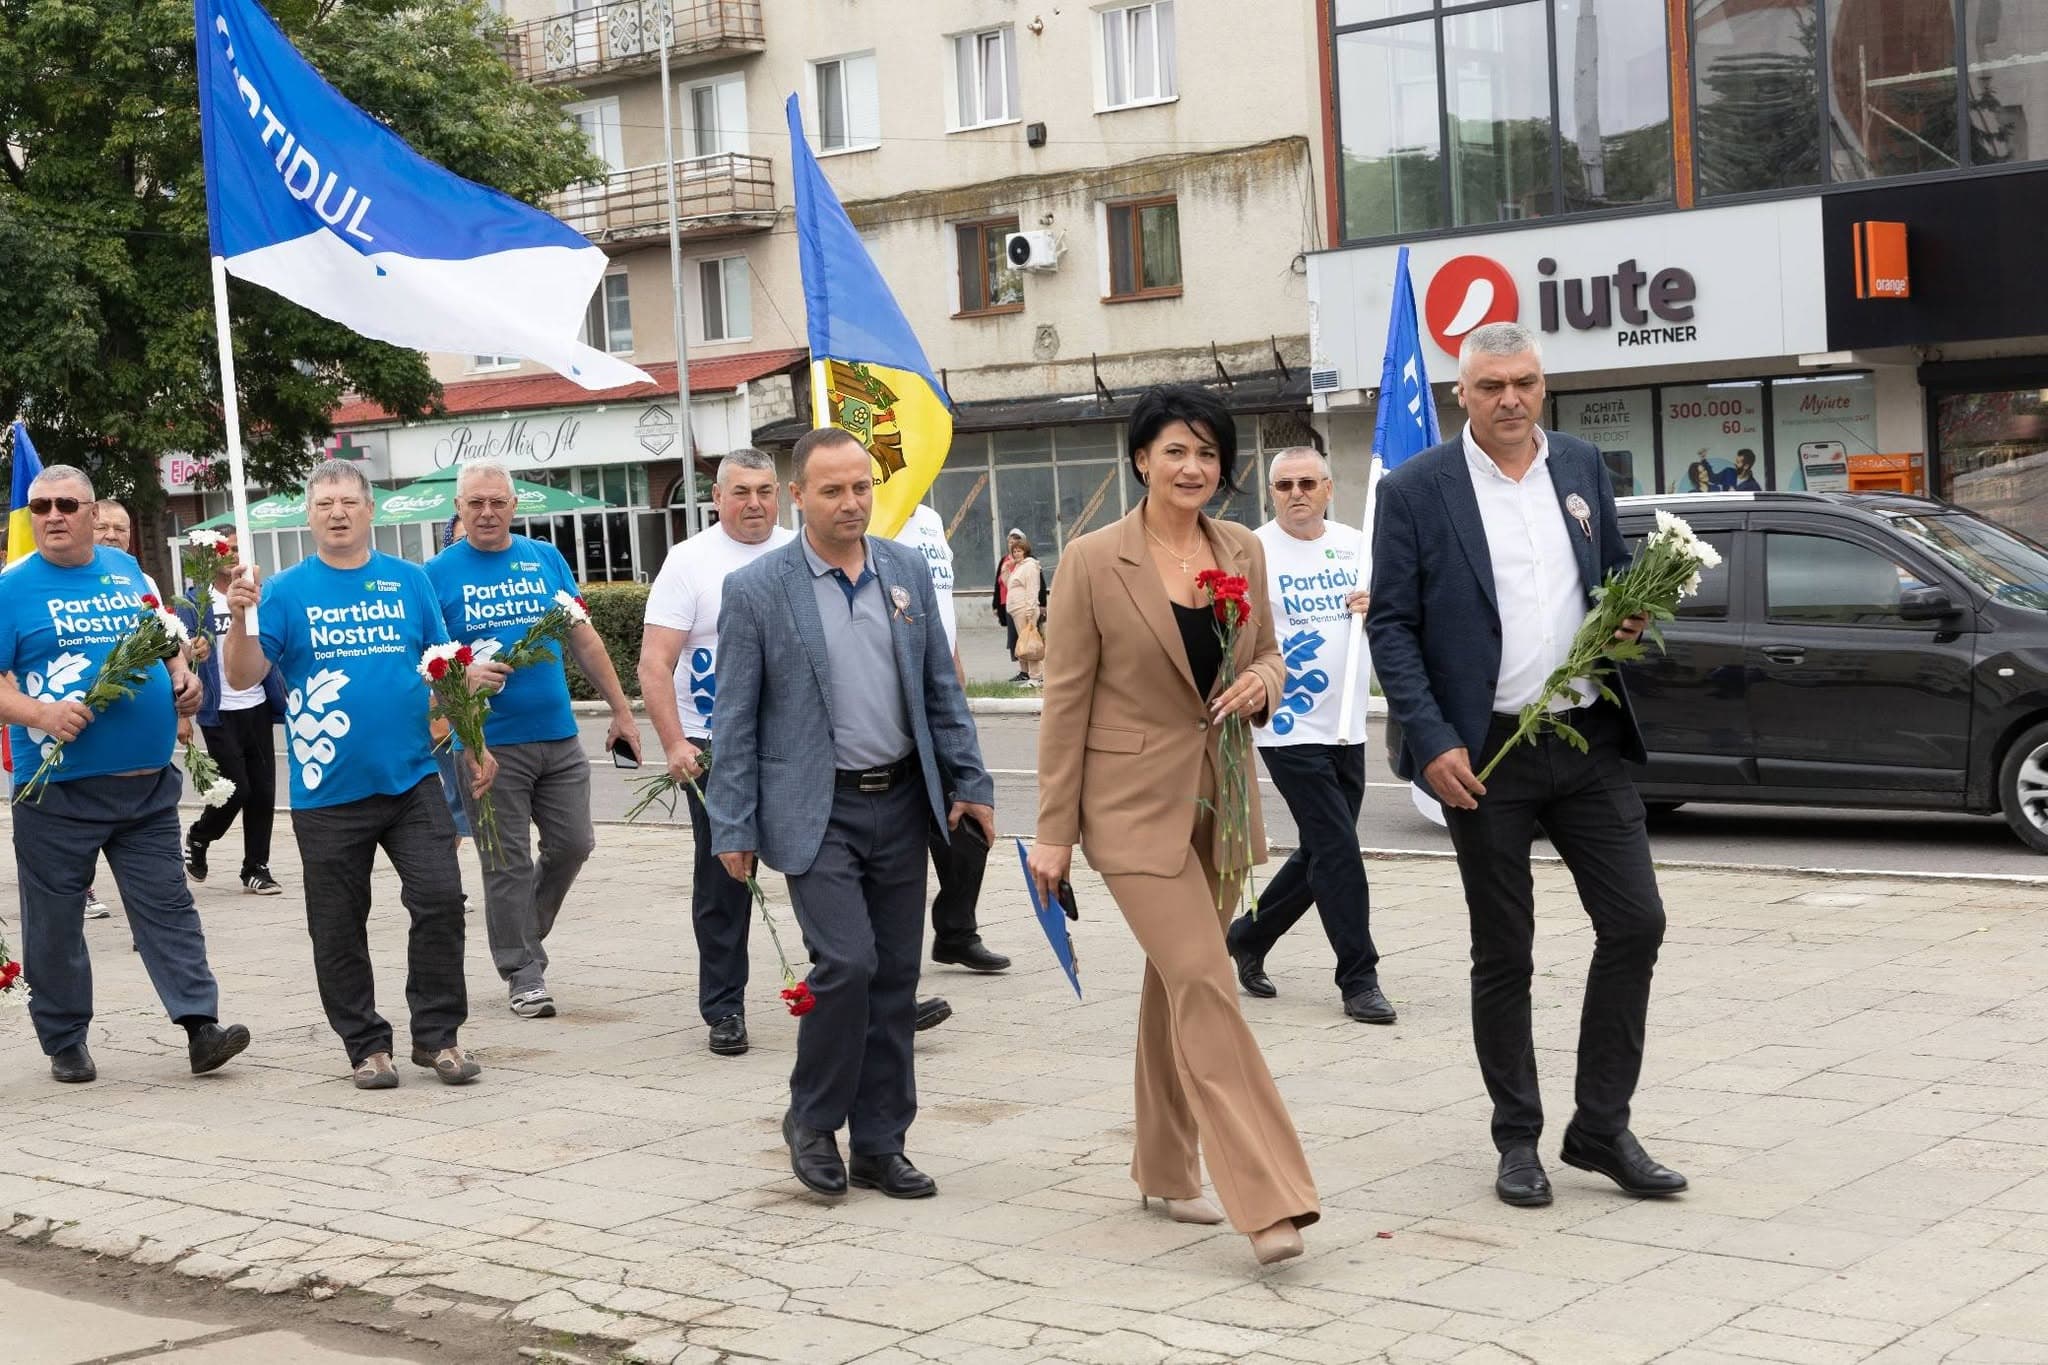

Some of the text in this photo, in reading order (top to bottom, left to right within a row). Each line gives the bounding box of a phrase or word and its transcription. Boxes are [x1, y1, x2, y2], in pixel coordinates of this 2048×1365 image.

[1537, 257, 1697, 335] iute
[1876, 279, 1906, 295] orange
[1618, 325, 1697, 347] PARTNER
[1669, 399, 1742, 419] 300.000
[1800, 393, 1850, 415] Myiute
[1593, 414, 1600, 424] 4
[1602, 413, 1631, 425] RATE
[1722, 420, 1741, 434] 60
[1603, 431, 1631, 442] COST
[463, 577, 547, 602] Partidul
[1278, 567, 1359, 594] Partidu
[306, 599, 406, 625] Partidul
[464, 599, 546, 622] Nostru.
[1289, 617, 1309, 626] Doar
[1311, 614, 1337, 623] Pentru
[466, 622, 487, 632] Doar
[488, 617, 516, 629] Pentru
[58, 636, 84, 648] Doar
[84, 633, 118, 645] Pentru
[310, 624, 401, 649] Nostru.
[314, 651, 336, 661] Doar
[336, 647, 368, 658] Pentru
